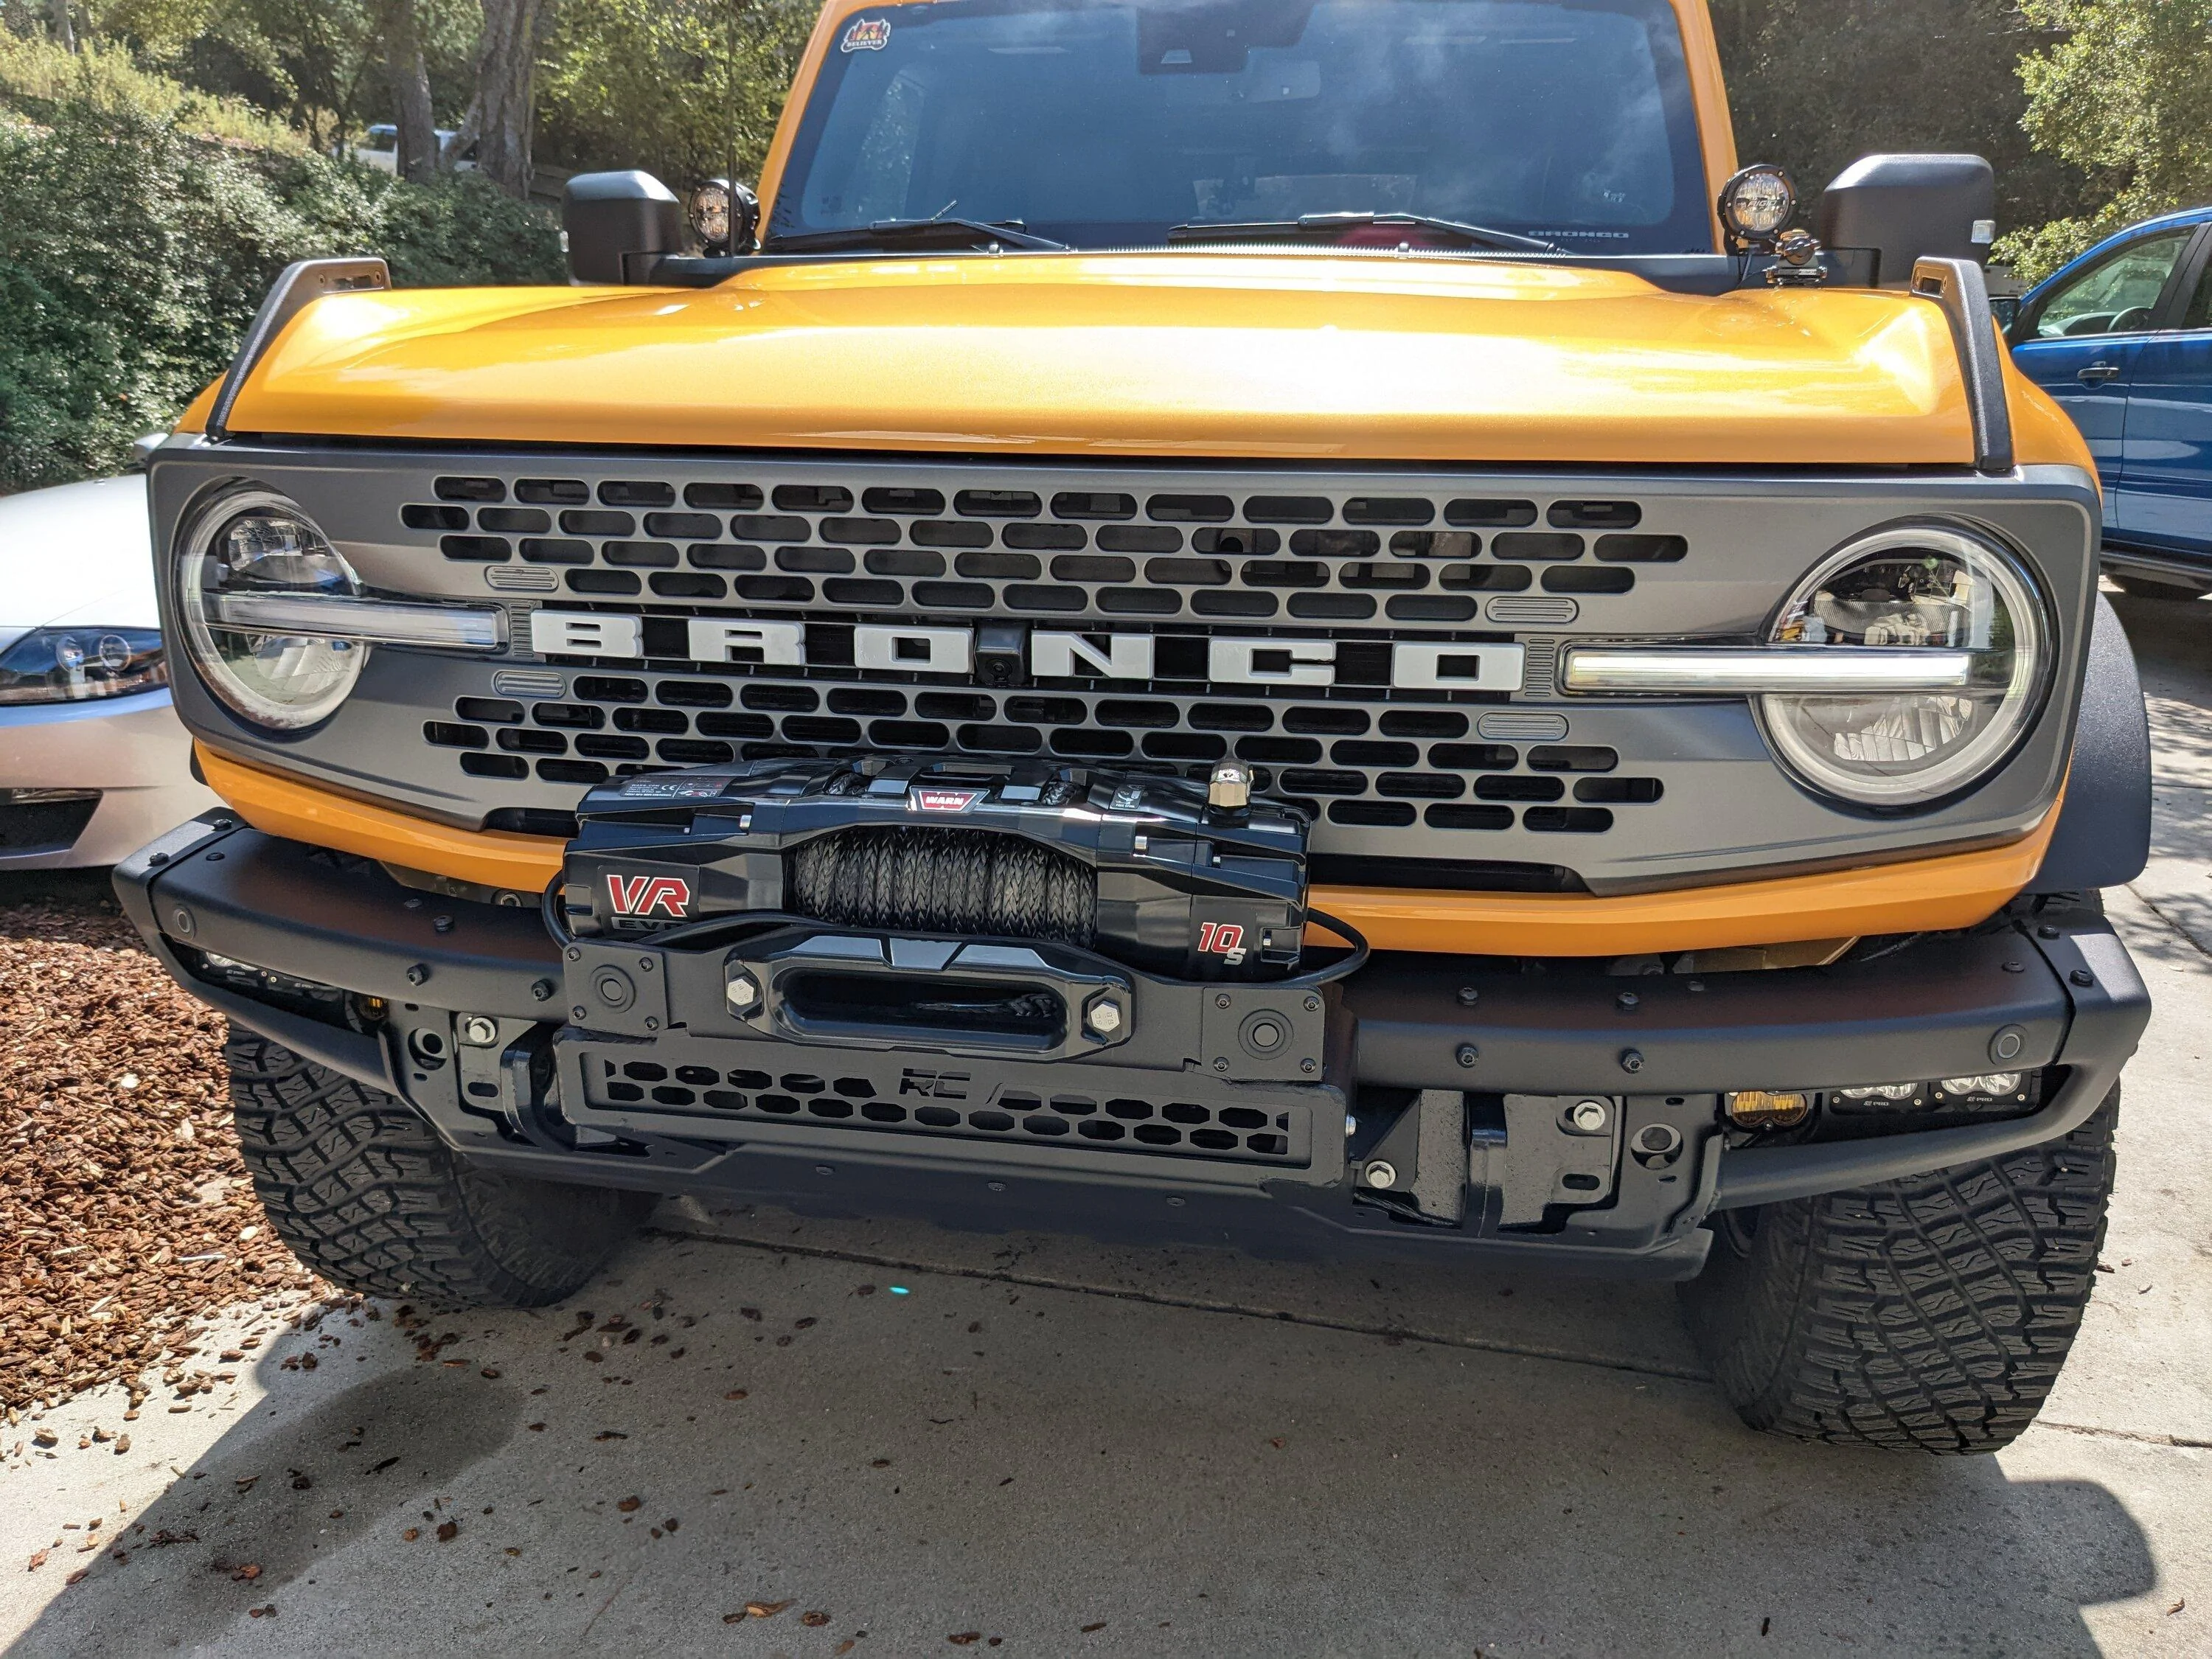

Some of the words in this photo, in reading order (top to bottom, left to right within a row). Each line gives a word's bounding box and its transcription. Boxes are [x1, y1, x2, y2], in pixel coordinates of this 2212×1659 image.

[531, 608, 1526, 692] BRONCO
[925, 796, 964, 805] WARN
[607, 874, 690, 917] VR
